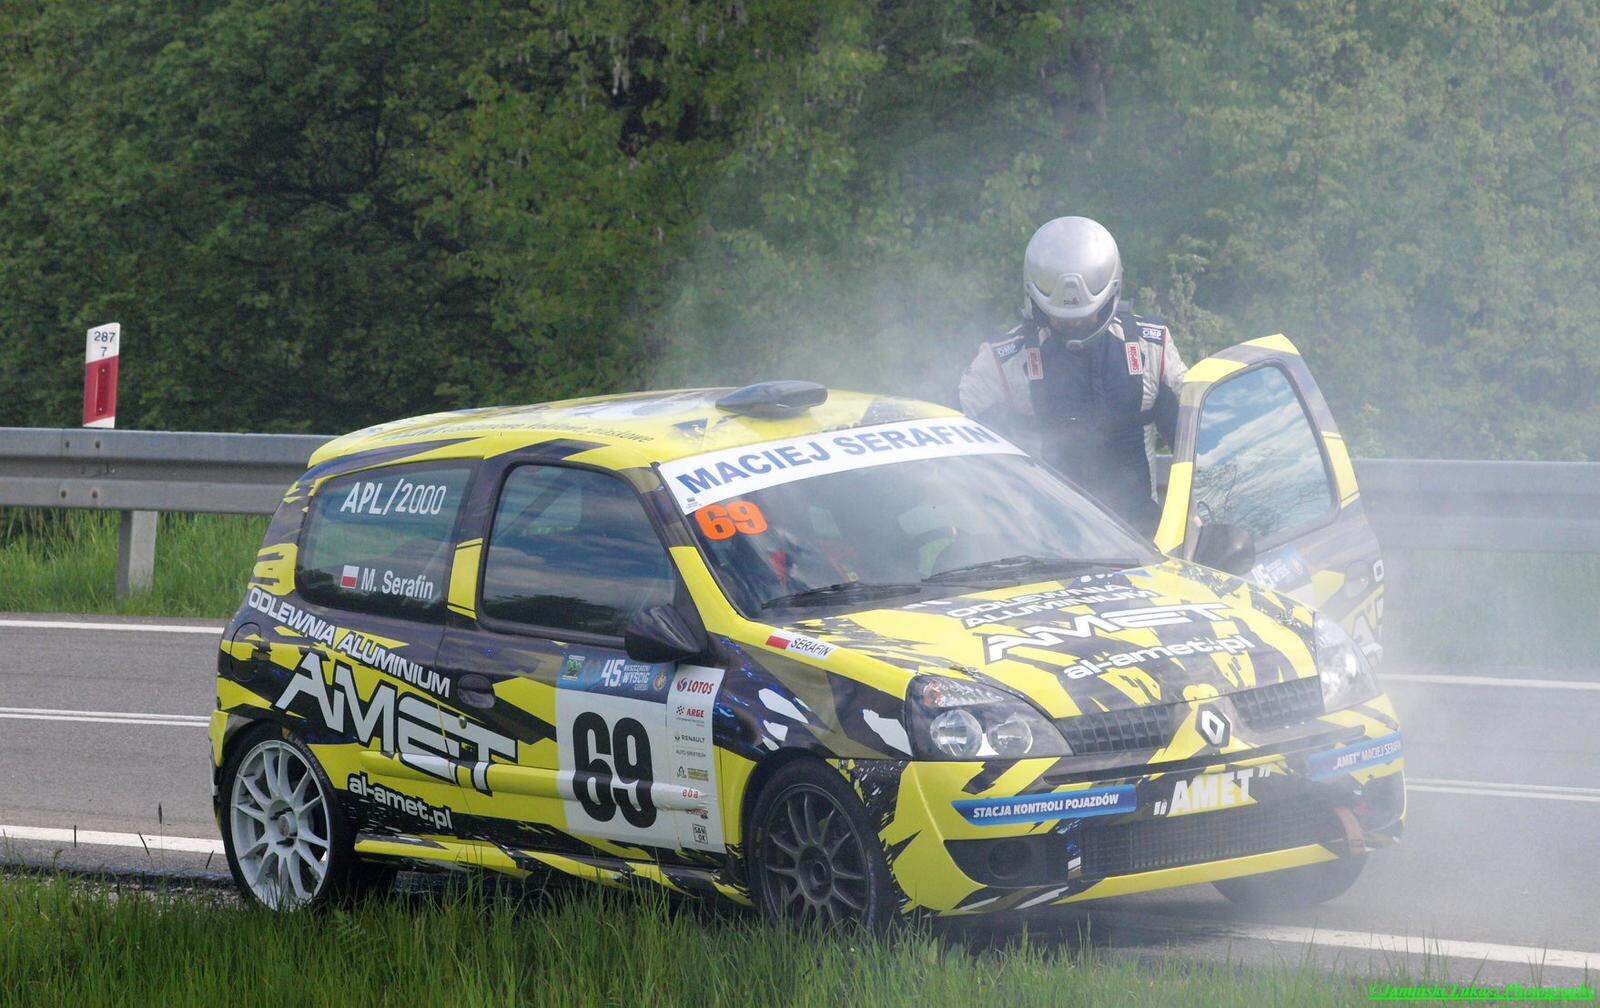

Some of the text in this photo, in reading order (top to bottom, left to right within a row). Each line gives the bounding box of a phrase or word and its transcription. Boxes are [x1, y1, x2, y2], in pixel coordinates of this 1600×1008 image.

[94, 330, 116, 342] 287
[100, 346, 108, 357] 7
[676, 424, 999, 494] MACIEJ SERAFIN
[340, 478, 448, 516] APL/2000
[695, 500, 768, 540] 69
[361, 567, 434, 599] M. Serafin
[947, 584, 1132, 618] ODLEWNIA
[248, 587, 335, 643] ODLEWNIA
[966, 590, 1161, 629] ALUMINIUM
[791, 638, 831, 656] SERAFIN
[985, 602, 1233, 664] AMET
[337, 631, 451, 698] ALUMINIUM
[1064, 634, 1255, 680] al-amet.pl
[687, 680, 714, 695] LOTOS
[273, 650, 518, 797] AMET
[573, 711, 657, 829] 69
[348, 773, 453, 830] al-amet.pl
[973, 792, 1119, 818] STACJA KONTROLI POJAZDÓW
